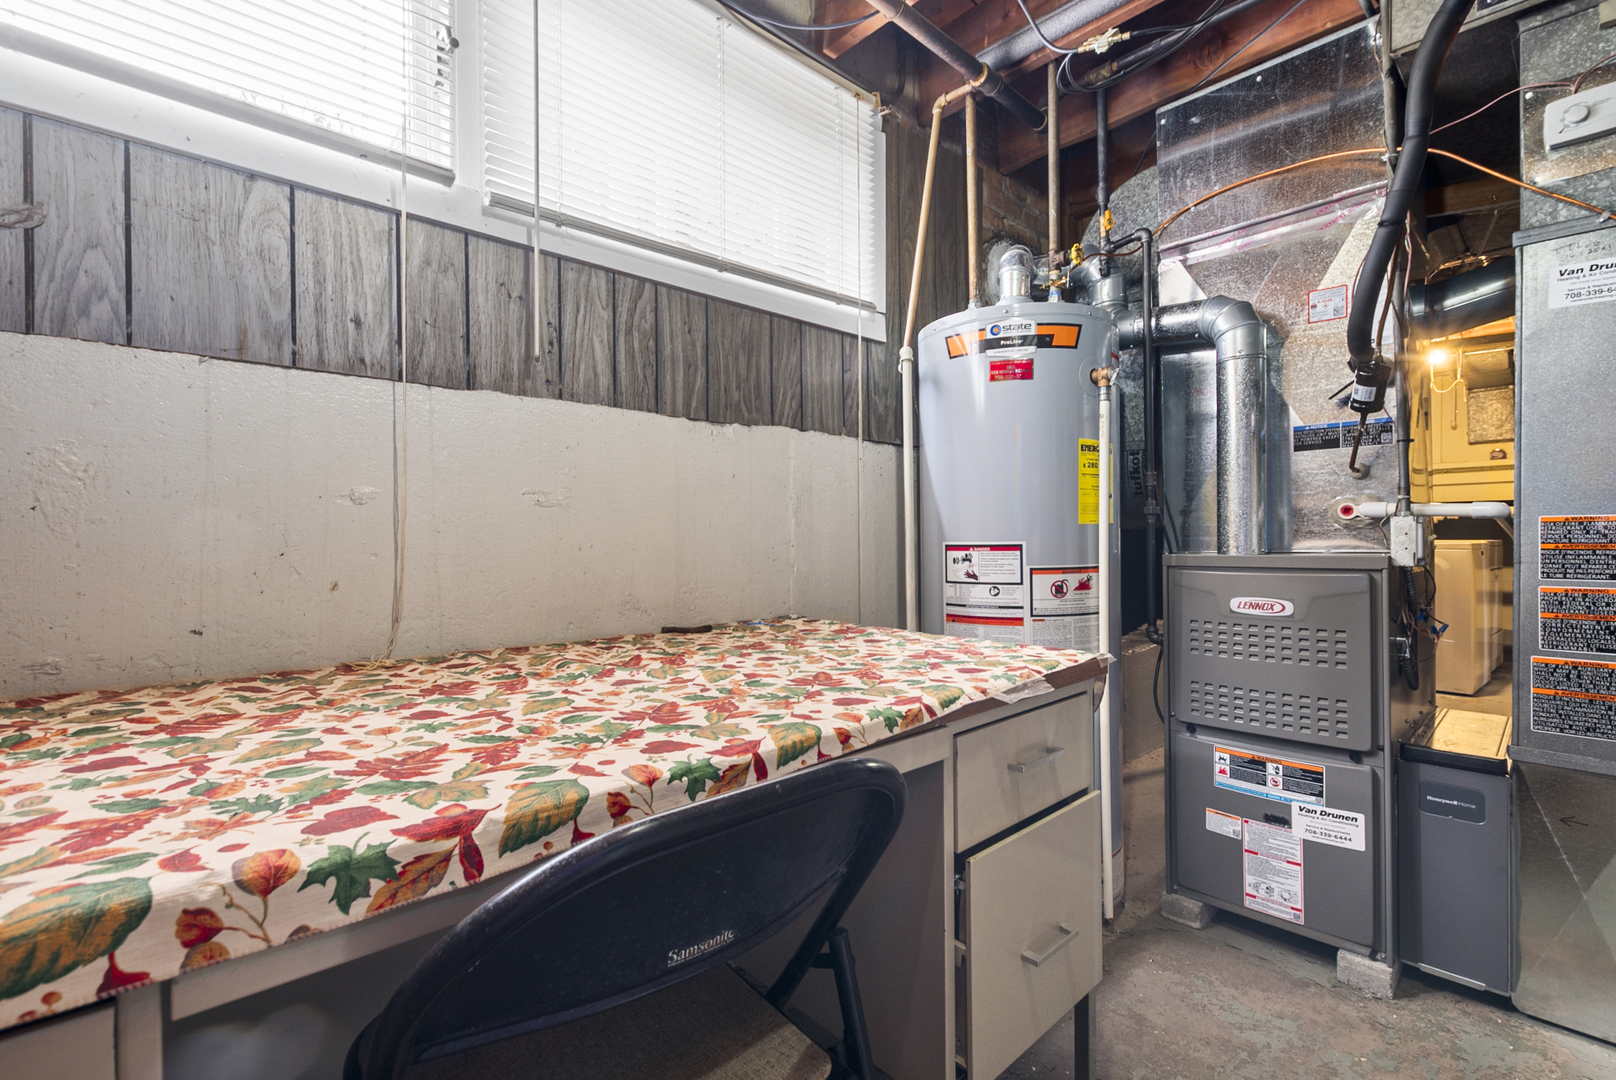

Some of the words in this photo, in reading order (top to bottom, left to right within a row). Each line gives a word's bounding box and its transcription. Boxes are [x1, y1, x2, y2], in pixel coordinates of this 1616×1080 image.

[1559, 268, 1584, 276] Van
[1237, 601, 1276, 611] LENNOX
[1256, 756, 1282, 765] WARNING
[1426, 795, 1457, 805] Honeywell
[1298, 806, 1317, 815] Van
[1319, 810, 1358, 823] Drunen
[1298, 813, 1315, 821] Heating
[1329, 819, 1359, 828] Conditioning
[1304, 828, 1352, 842] 708-339-6444
[668, 929, 735, 965] Samsonite
